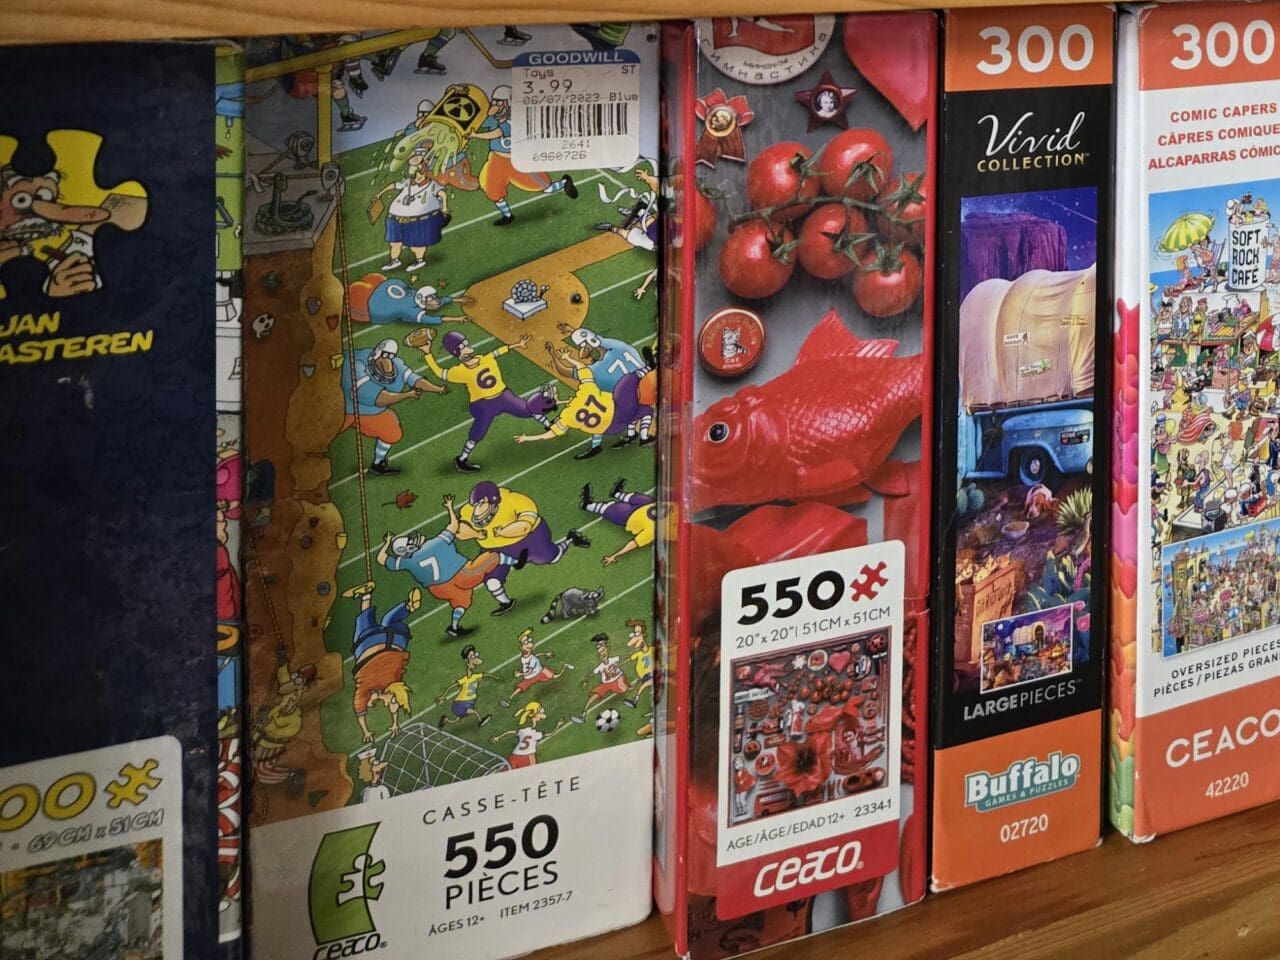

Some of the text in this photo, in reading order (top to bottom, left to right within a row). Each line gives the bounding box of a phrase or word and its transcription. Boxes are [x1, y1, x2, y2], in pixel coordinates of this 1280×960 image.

[528, 51, 625, 65] GOODWILL
[976, 24, 1094, 75] 300
[1170, 19, 1275, 70] 300
[523, 65, 636, 79] Toys ST
[523, 79, 573, 94] 3.99
[523, 92, 639, 105] 06/07/2023 Blue
[1170, 103, 1277, 123] COMIC CAPERS
[561, 140, 590, 150] 2641
[977, 111, 1086, 156] Vivid
[977, 153, 1085, 172] COLLECTION
[1148, 150, 1236, 170] ALCAPARRAS
[1232, 229, 1261, 246] SOFT
[1232, 248, 1260, 266] ROCK
[0, 311, 60, 337] JAN
[608, 351, 647, 375] 71
[476, 368, 497, 389] 6
[575, 394, 607, 429] 87
[418, 556, 440, 581] 7
[737, 570, 845, 625] 550
[802, 616, 841, 635] 51CM
[853, 606, 891, 625] 51CM
[1171, 651, 1238, 679] OVERSIZED
[1153, 679, 1194, 697] PIÈCES
[1204, 664, 1244, 682] PIEZAS
[966, 753, 1079, 804] Buffalo
[984, 778, 1069, 807] GAMES PUZZLES
[1205, 771, 1250, 798] 42220
[422, 775, 581, 825] CASSE-TÊTE
[828, 813, 846, 826] 12+
[854, 798, 892, 818] 2334-1
[109, 808, 165, 836] 51CM
[1001, 814, 1049, 843] 02720
[443, 814, 560, 879] 550
[753, 840, 862, 897] ceaco
[445, 860, 560, 910] PIÈCES
[500, 901, 530, 920] ITEM
[533, 890, 574, 911] 2357-7
[313, 933, 381, 960] ceaco
